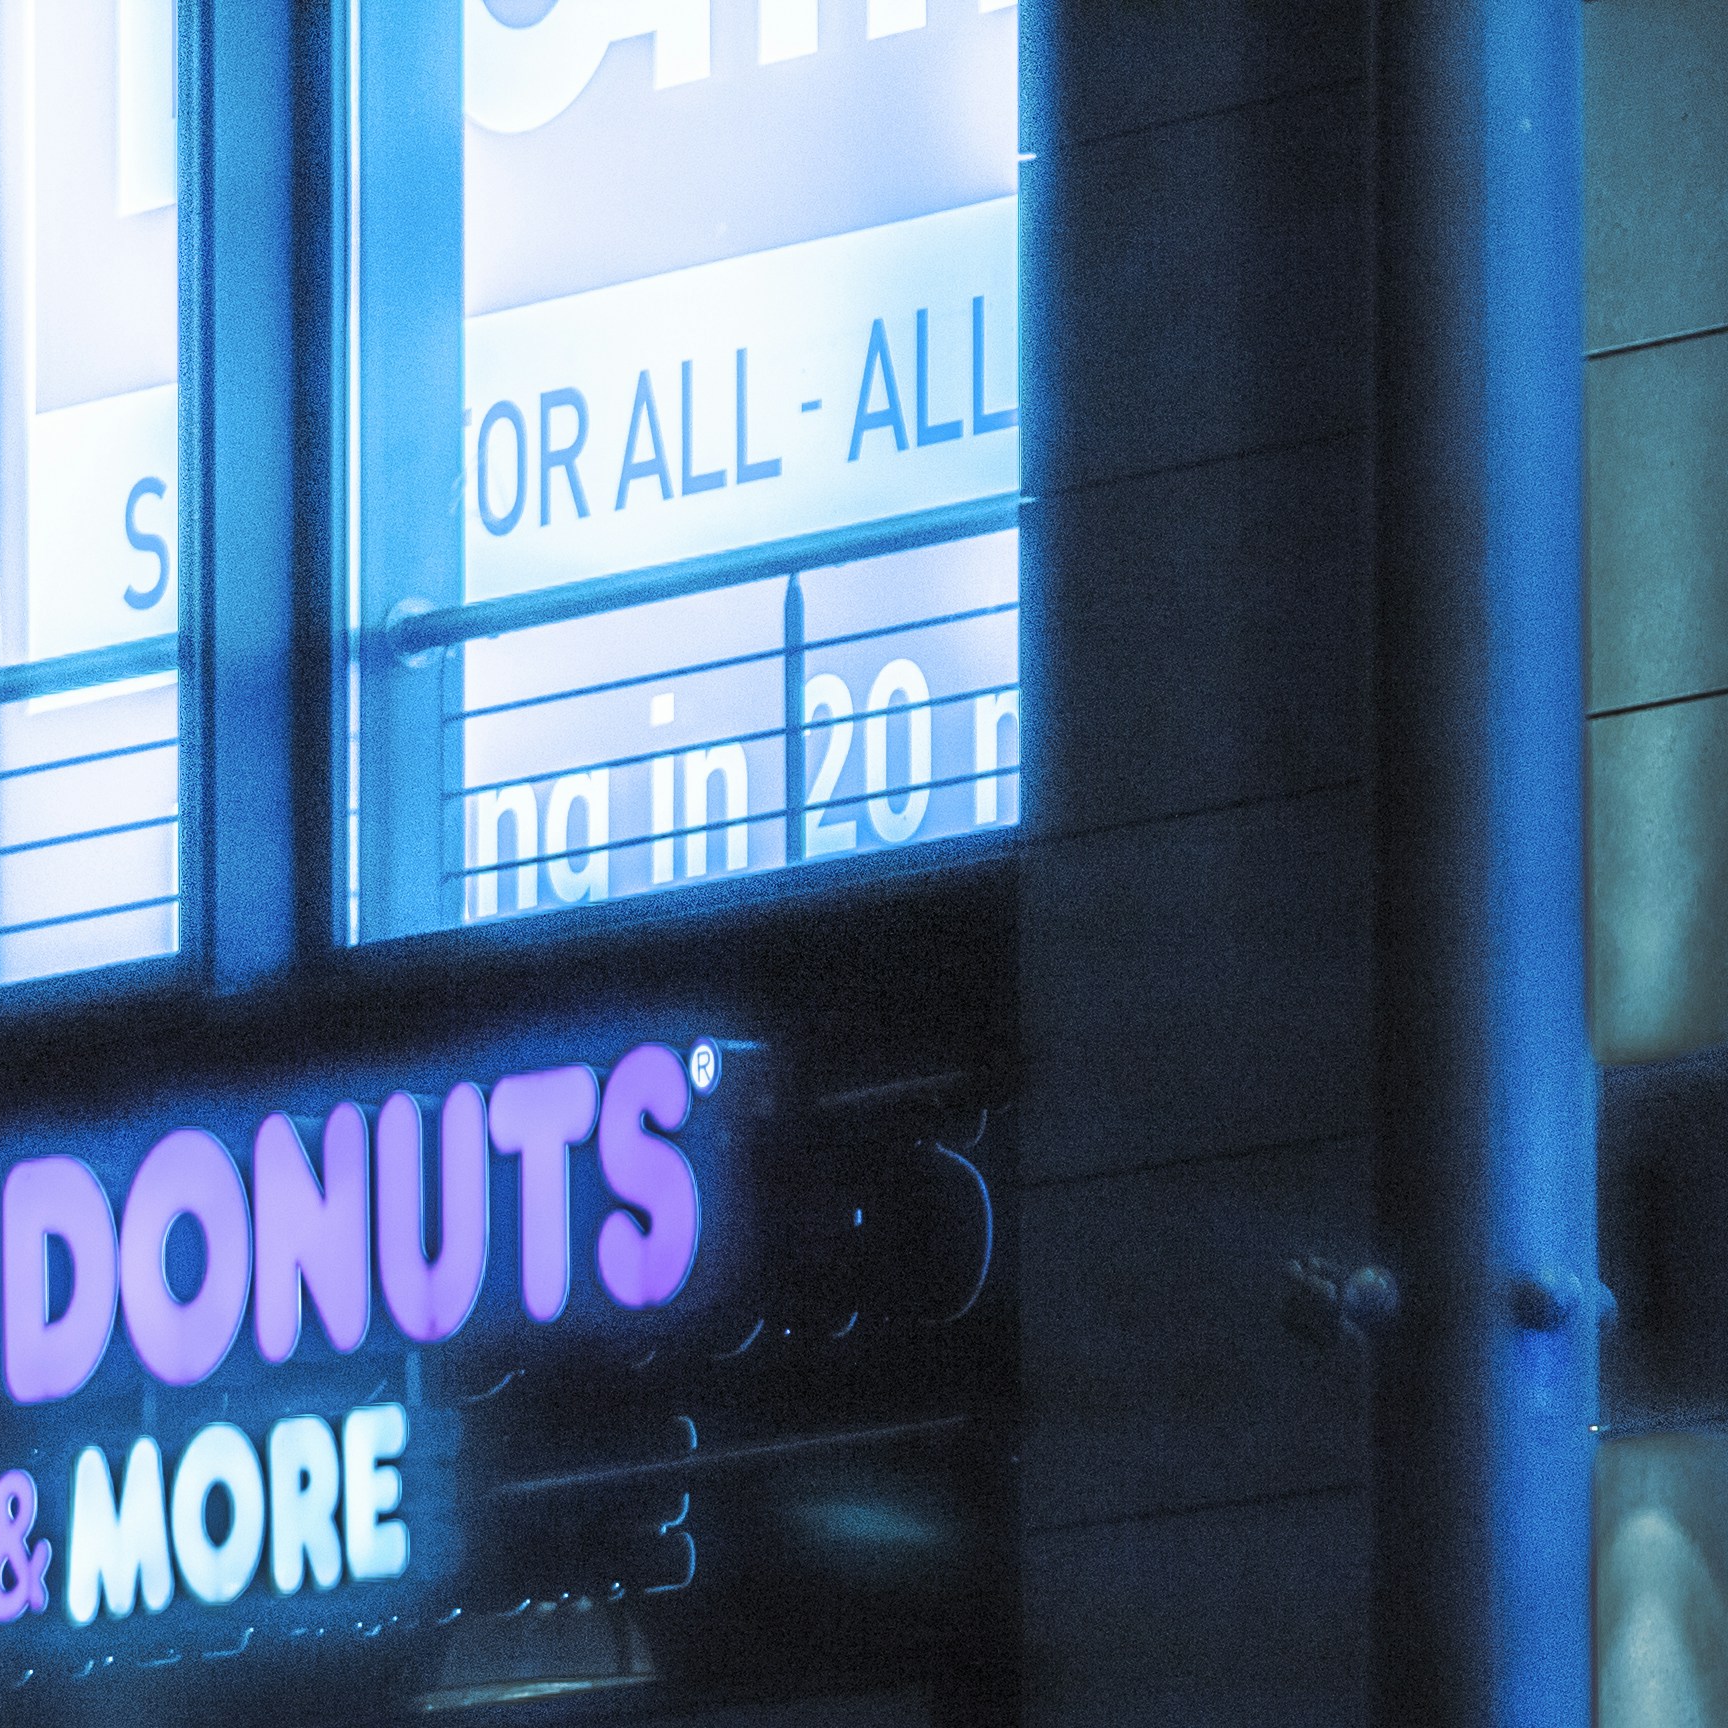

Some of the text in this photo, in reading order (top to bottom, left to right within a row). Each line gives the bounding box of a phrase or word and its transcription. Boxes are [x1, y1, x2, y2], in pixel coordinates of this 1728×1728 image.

[465, 384, 592, 538] OR
[614, 347, 783, 512] ALL
[650, 691, 750, 885] in
[802, 657, 933, 859] 20
[66, 1402, 410, 1628] MORE
